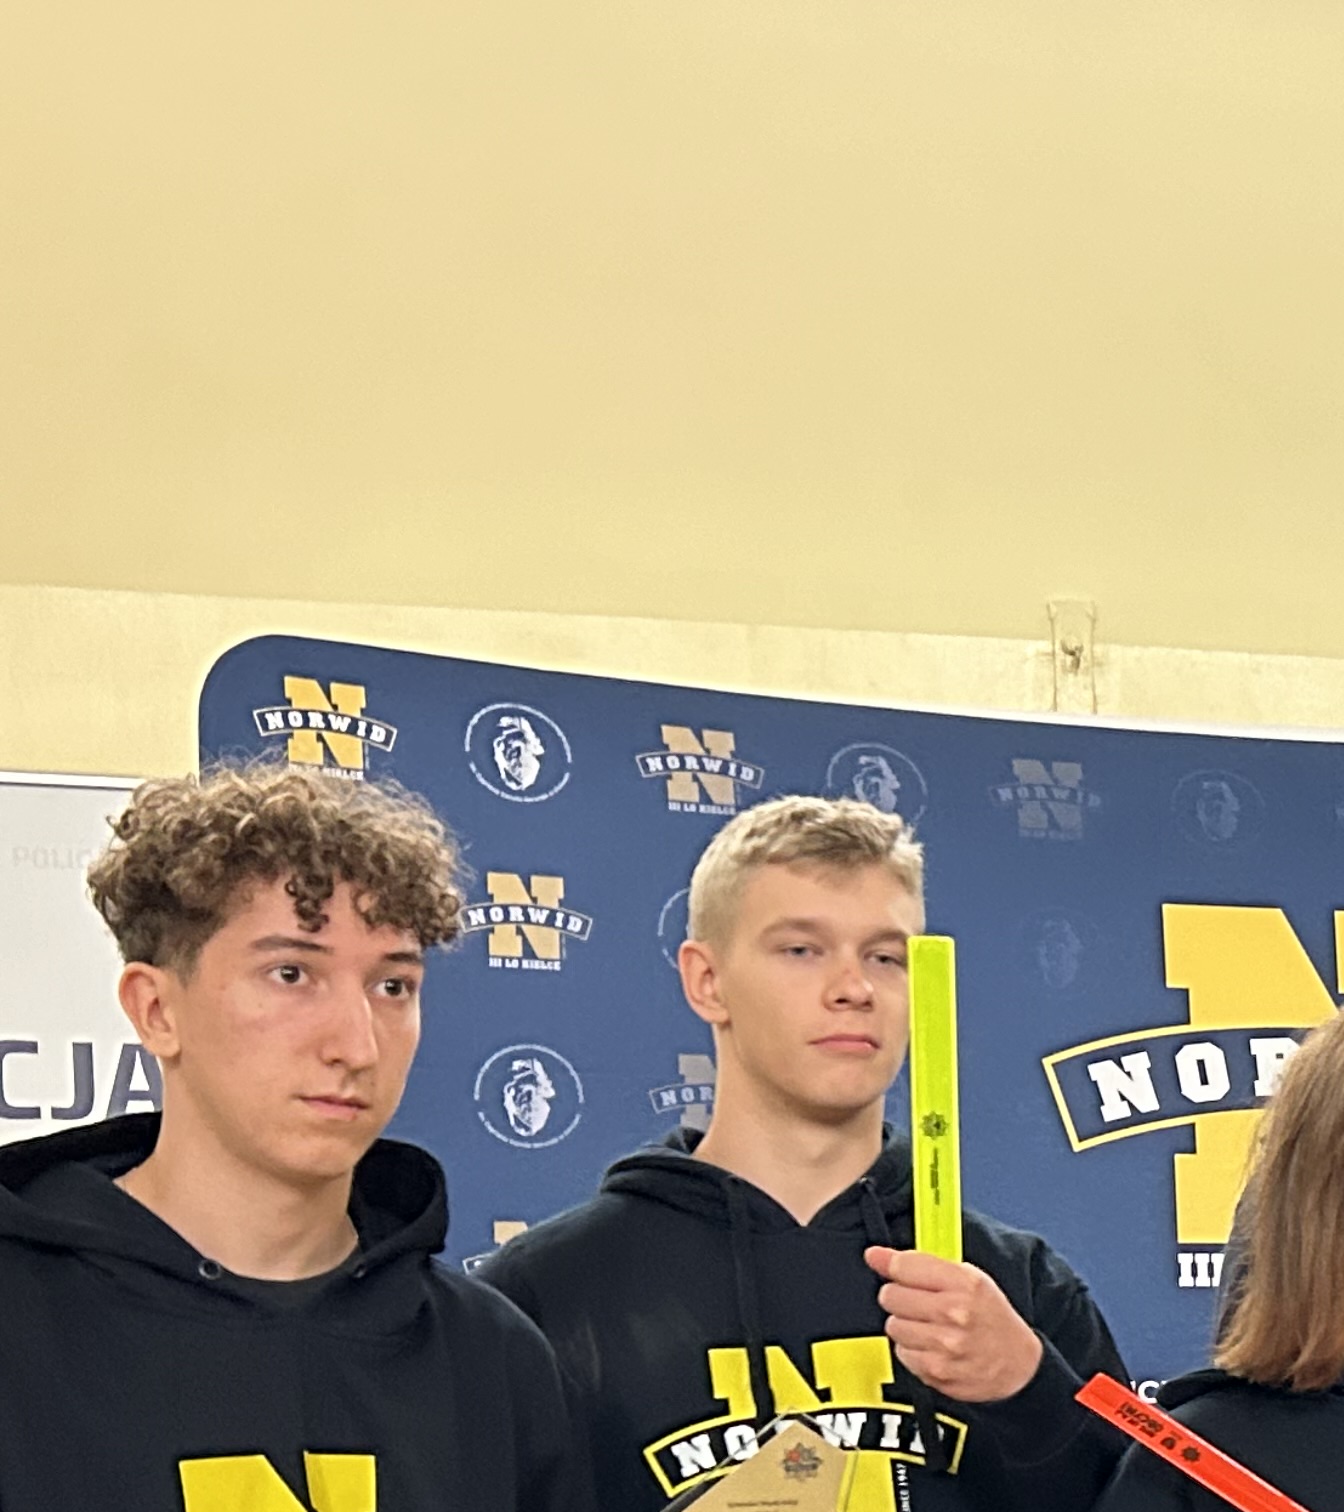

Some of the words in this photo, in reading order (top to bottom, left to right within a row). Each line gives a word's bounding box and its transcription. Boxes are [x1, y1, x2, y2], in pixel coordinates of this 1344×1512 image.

[265, 710, 387, 743] NORWID
[645, 755, 755, 781] NORWID
[467, 906, 584, 932] NORWID
